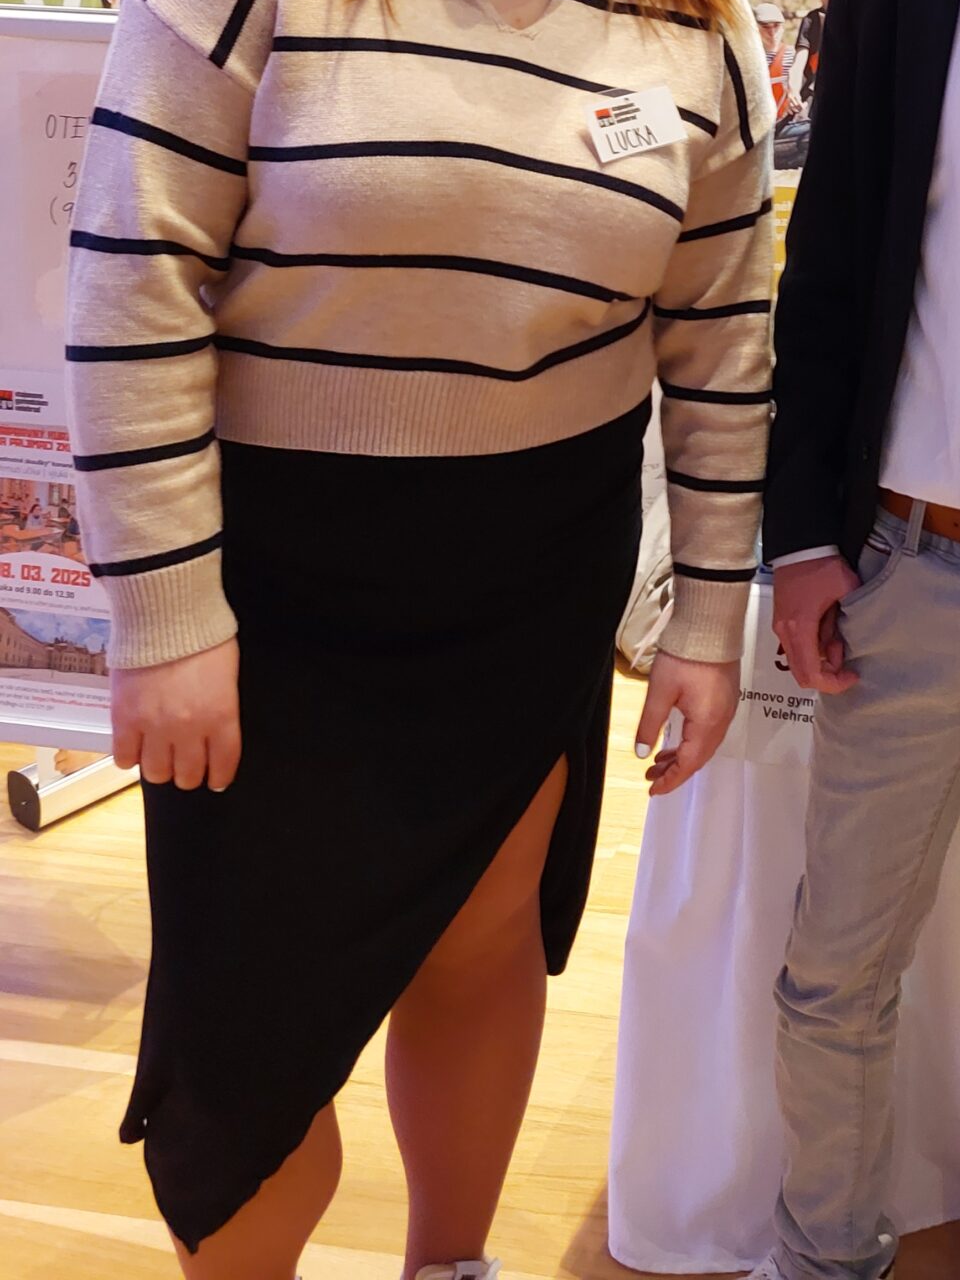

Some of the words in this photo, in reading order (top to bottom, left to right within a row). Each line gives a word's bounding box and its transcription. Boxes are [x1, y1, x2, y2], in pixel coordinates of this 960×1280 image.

[605, 125, 658, 155] LUCKA
[21, 564, 45, 582] 03.
[50, 567, 91, 587] 2025
